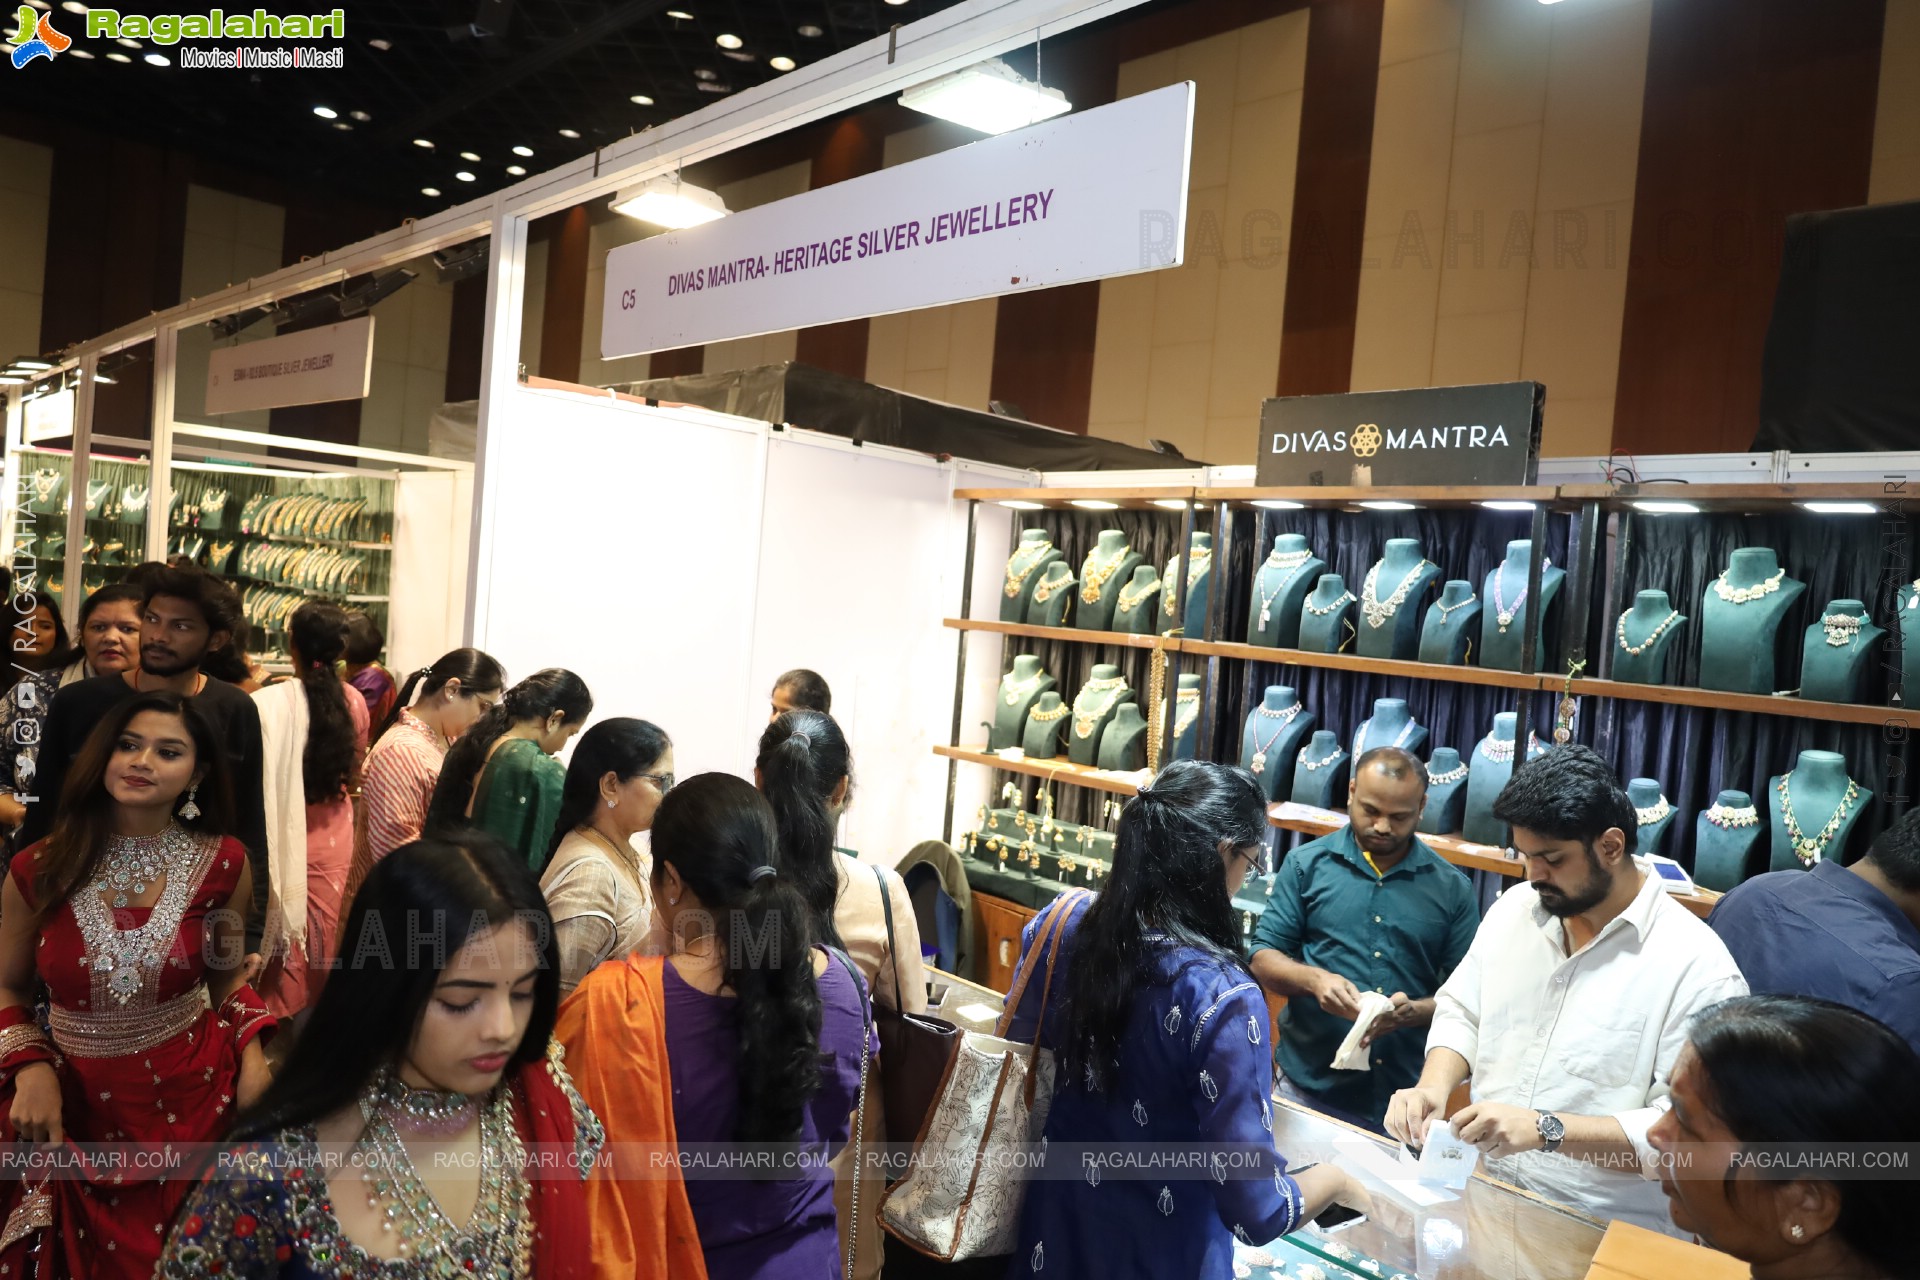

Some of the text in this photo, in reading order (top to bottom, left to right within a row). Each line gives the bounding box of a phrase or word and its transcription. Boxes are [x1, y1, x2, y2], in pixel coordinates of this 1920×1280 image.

[668, 188, 1054, 296] DIVAS MANTRA- HERITAGE SILVER JEWELLERY
[621, 288, 636, 311] C5
[1271, 424, 1510, 454] DIVAS MANTRA
